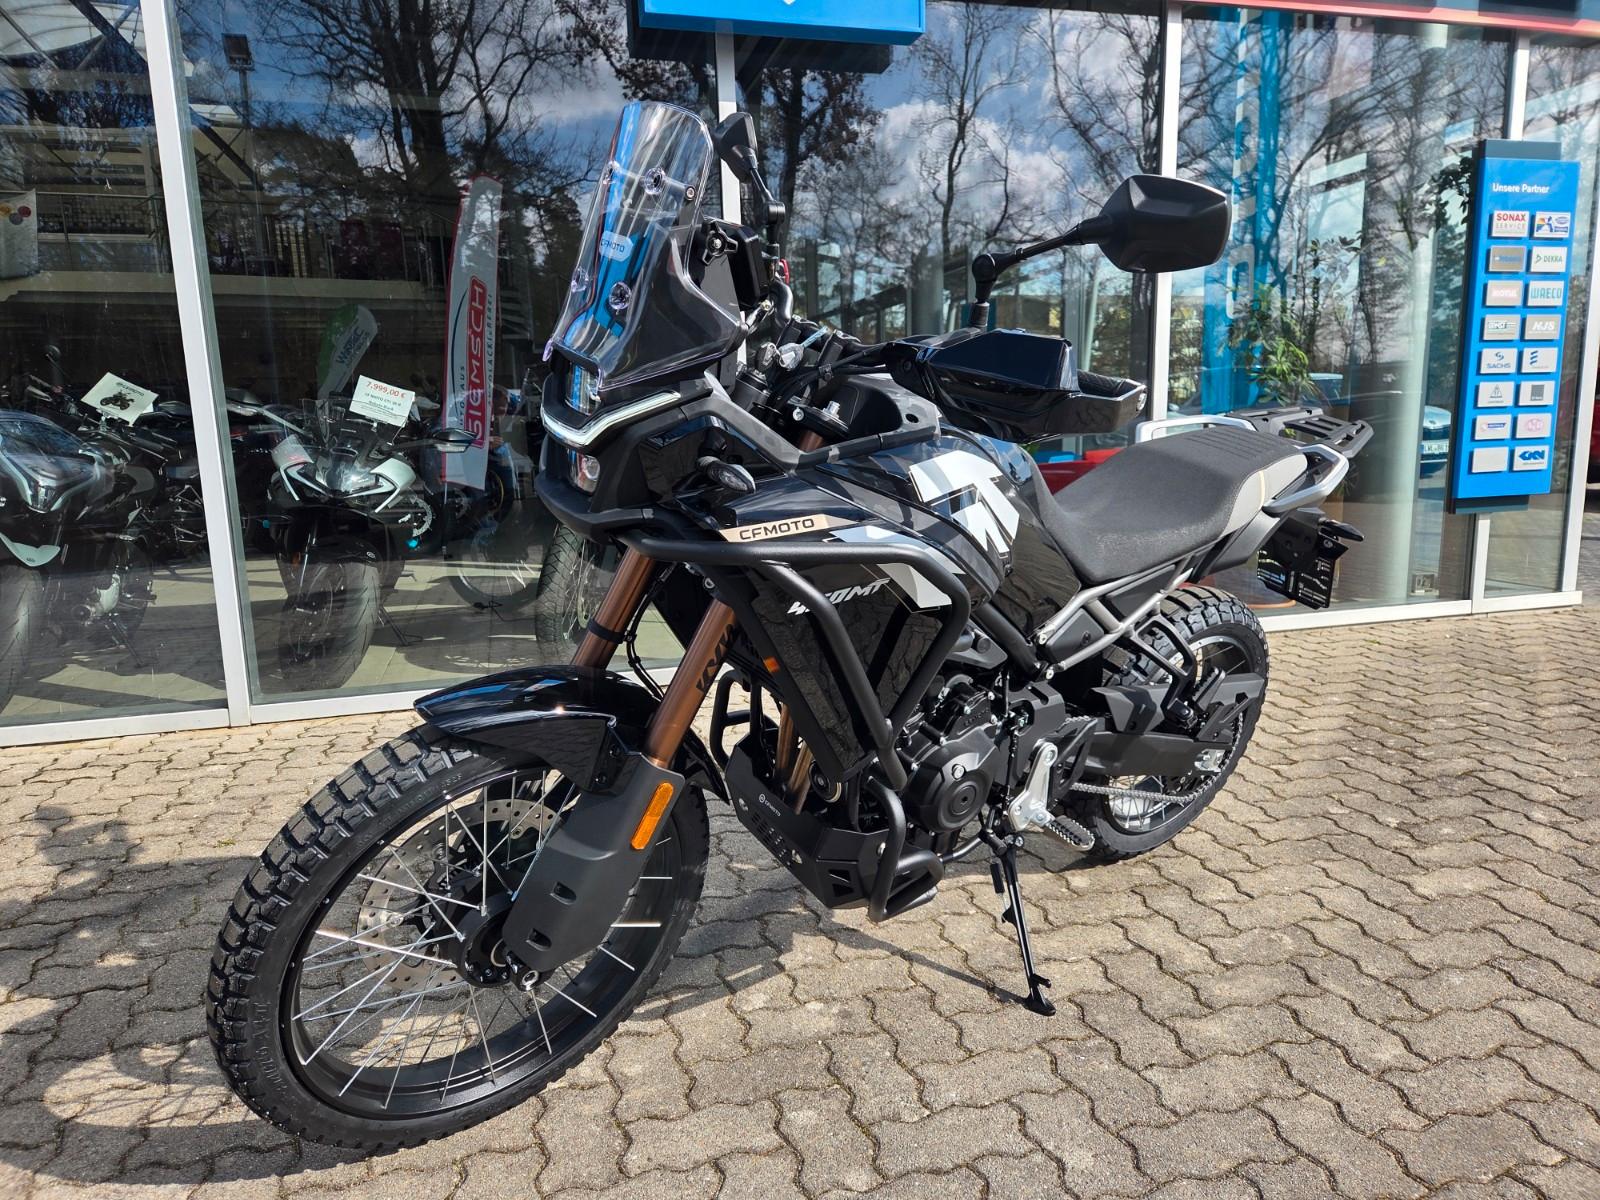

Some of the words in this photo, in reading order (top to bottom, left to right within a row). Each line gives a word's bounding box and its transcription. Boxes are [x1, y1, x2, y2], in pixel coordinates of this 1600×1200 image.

[1493, 183, 1520, 192] Unsere
[1522, 184, 1549, 193] Partner
[1496, 213, 1526, 221] SONAX
[1531, 287, 1562, 299] WAECO
[366, 381, 400, 397] 7.999,00
[739, 518, 815, 541] CFMOTO
